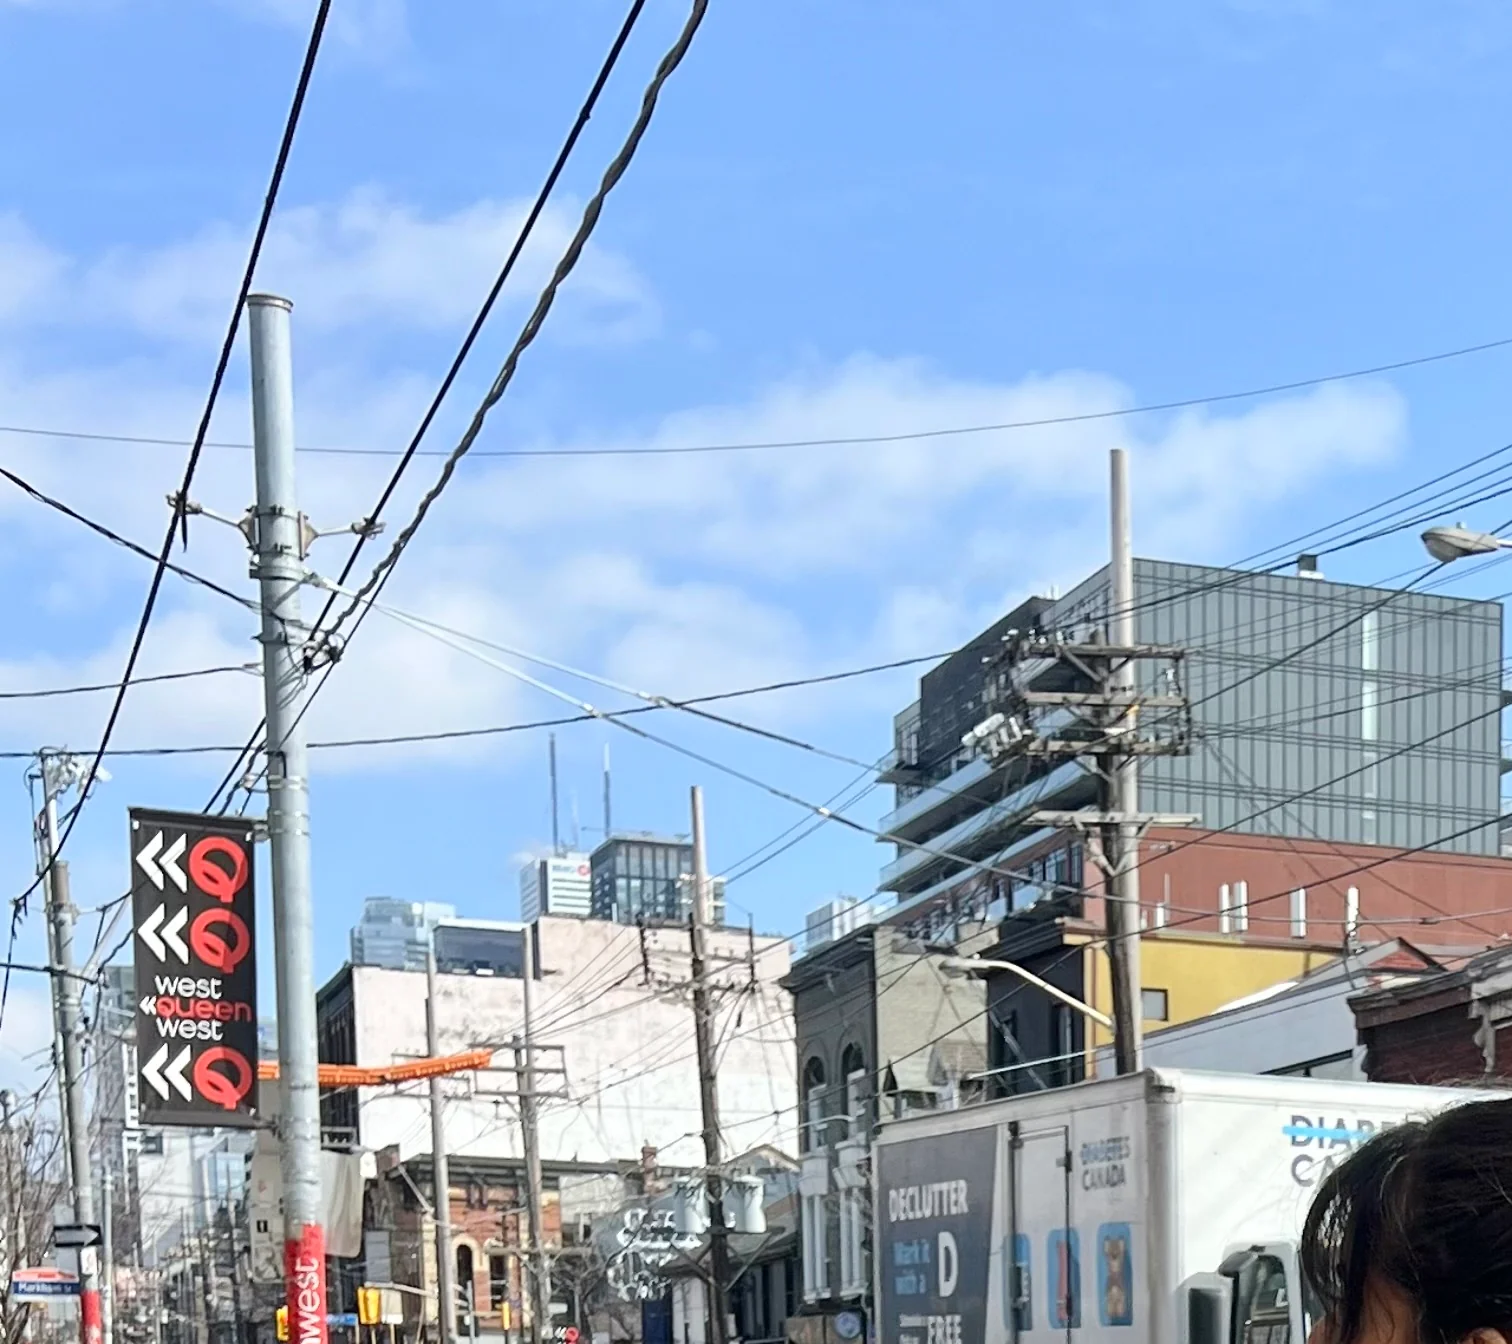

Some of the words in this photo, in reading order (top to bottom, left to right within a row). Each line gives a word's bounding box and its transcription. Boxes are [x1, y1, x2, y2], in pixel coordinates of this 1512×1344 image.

[189, 836, 248, 902] Q
[190, 907, 250, 973] Q
[154, 975, 222, 999] west
[156, 1017, 223, 1040] west
[193, 1045, 253, 1110] Q
[889, 1179, 969, 1222] DECLUTTER
[1082, 1164, 1127, 1190] CANADA
[937, 1231, 959, 1297] D
